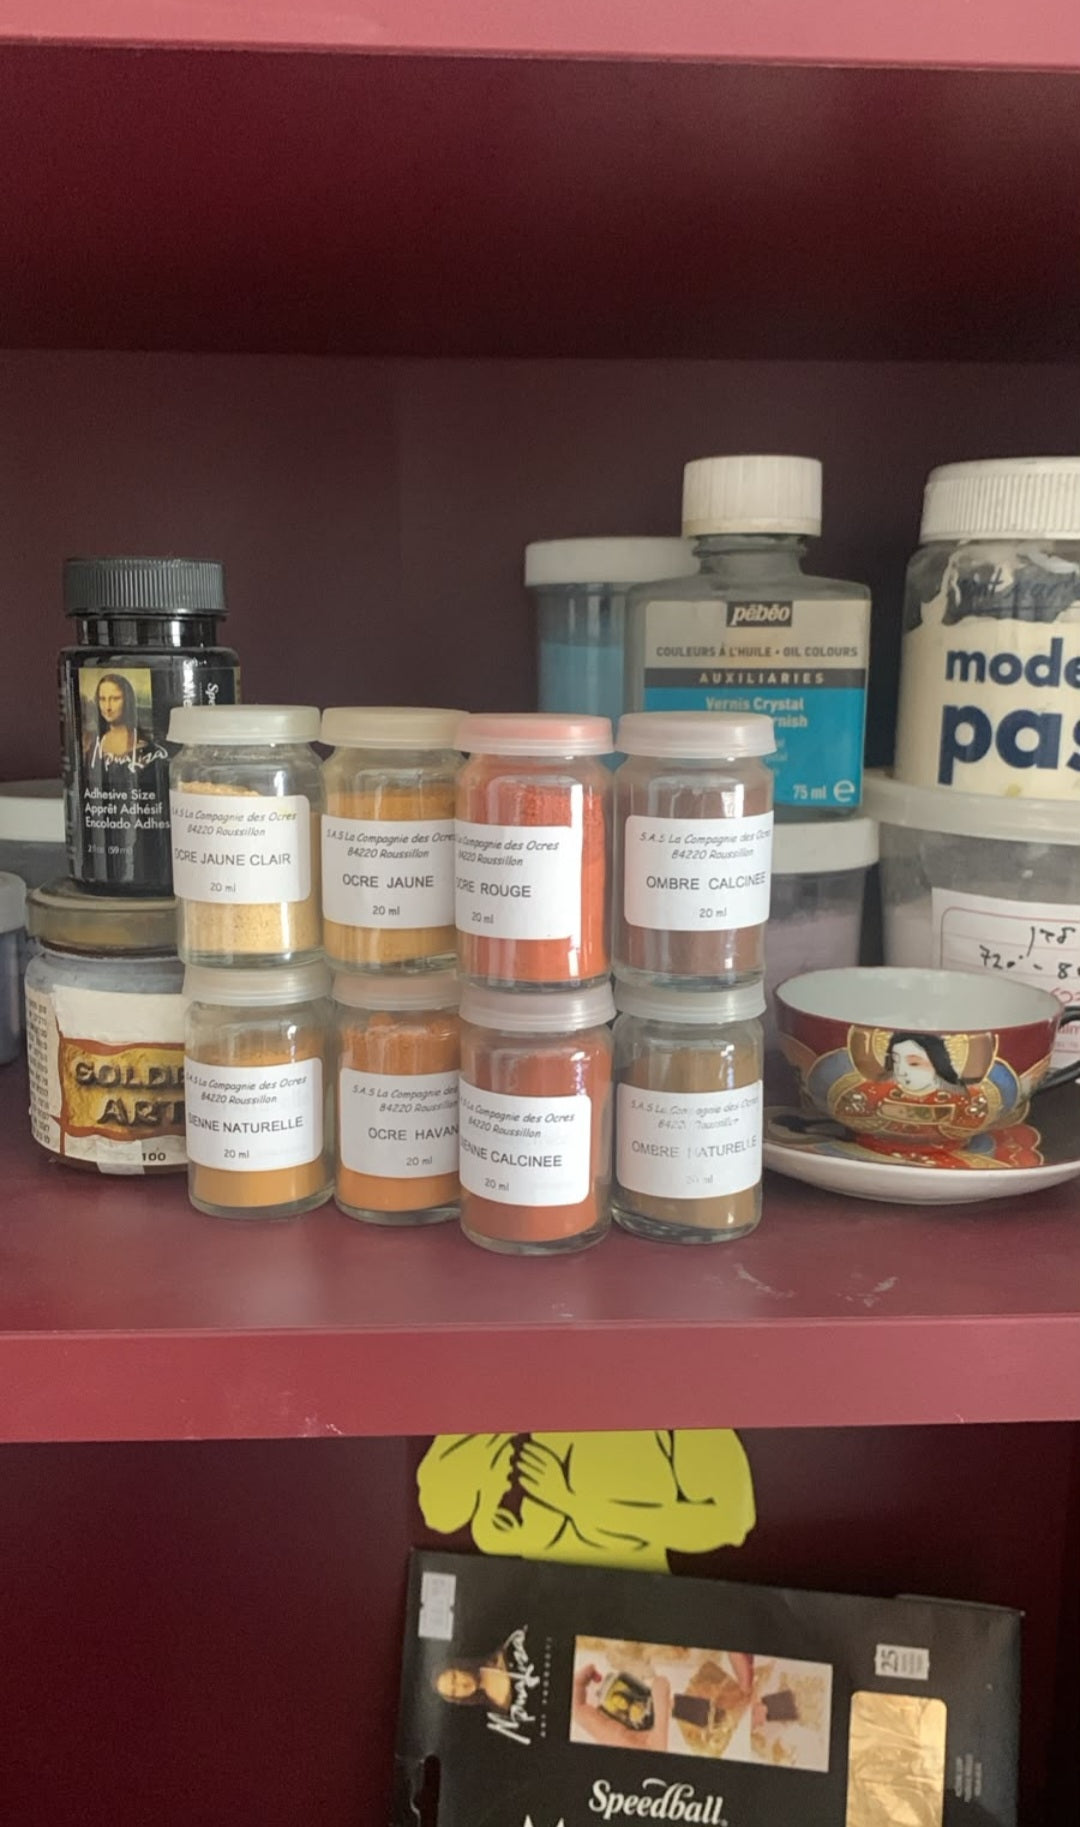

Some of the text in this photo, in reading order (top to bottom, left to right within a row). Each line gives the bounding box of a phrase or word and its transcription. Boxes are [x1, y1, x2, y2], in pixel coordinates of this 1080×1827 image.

[656, 646, 716, 658] COULEURS
[729, 646, 772, 658] L'HUILE
[783, 646, 802, 657] OIL
[805, 646, 858, 657] COLOURS
[699, 672, 825, 684] AUXILIARIES
[706, 696, 804, 714] Vernis Crystal
[84, 788, 155, 800] Adhesive Size
[793, 783, 808, 799] 75
[811, 784, 826, 799] ml
[85, 803, 163, 816] Apprêt Adhésif
[86, 817, 131, 829] Encolado
[194, 809, 244, 824] Compagnie
[247, 811, 265, 821] des
[268, 811, 297, 821] Ocres
[216, 826, 265, 836] Roussillon
[345, 832, 354, 841] La
[357, 833, 409, 845] Compagnie
[411, 833, 428, 843] des
[668, 833, 681, 844] La
[684, 833, 737, 847] Compagnie
[740, 831, 755, 842] des
[504, 840, 523, 851] des
[527, 840, 558, 851] Ocres
[200, 853, 245, 866] JAUNE
[249, 853, 291, 866] CLAIR
[348, 847, 430, 859] 84220 Roussillon
[478, 853, 523, 866] Roussillon
[671, 849, 707, 860] 84220
[210, 881, 236, 892] 20 ml
[342, 873, 434, 888] OCRE JAUNE
[646, 871, 766, 890] OMBRE CALCINEE
[480, 882, 531, 898] ROUGE
[372, 905, 400, 916] 20 ml
[699, 908, 727, 919] 20 ml
[472, 911, 494, 924] 20 ml
[208, 1079, 255, 1093] Compagnie
[259, 1080, 277, 1091] des
[280, 1076, 307, 1088] Ocres
[201, 1091, 277, 1105] 84220 Roussillon
[376, 1088, 388, 1098] La
[390, 1089, 441, 1100] Compagnie
[379, 1102, 412, 1113] 84220
[475, 1104, 520, 1122] Compagnie
[523, 1112, 542, 1123] des
[545, 1112, 576, 1124] Ocres
[223, 1116, 304, 1134] NATURELLE
[493, 1124, 542, 1138] Roussillon
[368, 1127, 407, 1141] OCRE
[224, 1149, 249, 1159] 20 ml
[632, 1140, 680, 1158] OMBRE
[142, 1152, 166, 1162] 100
[406, 1155, 433, 1167] 20 ml
[490, 1150, 563, 1168] CALCINEE
[484, 1177, 510, 1192] 20 ml
[881, 1649, 898, 1673] 25
[588, 1777, 724, 1825] Speedball
